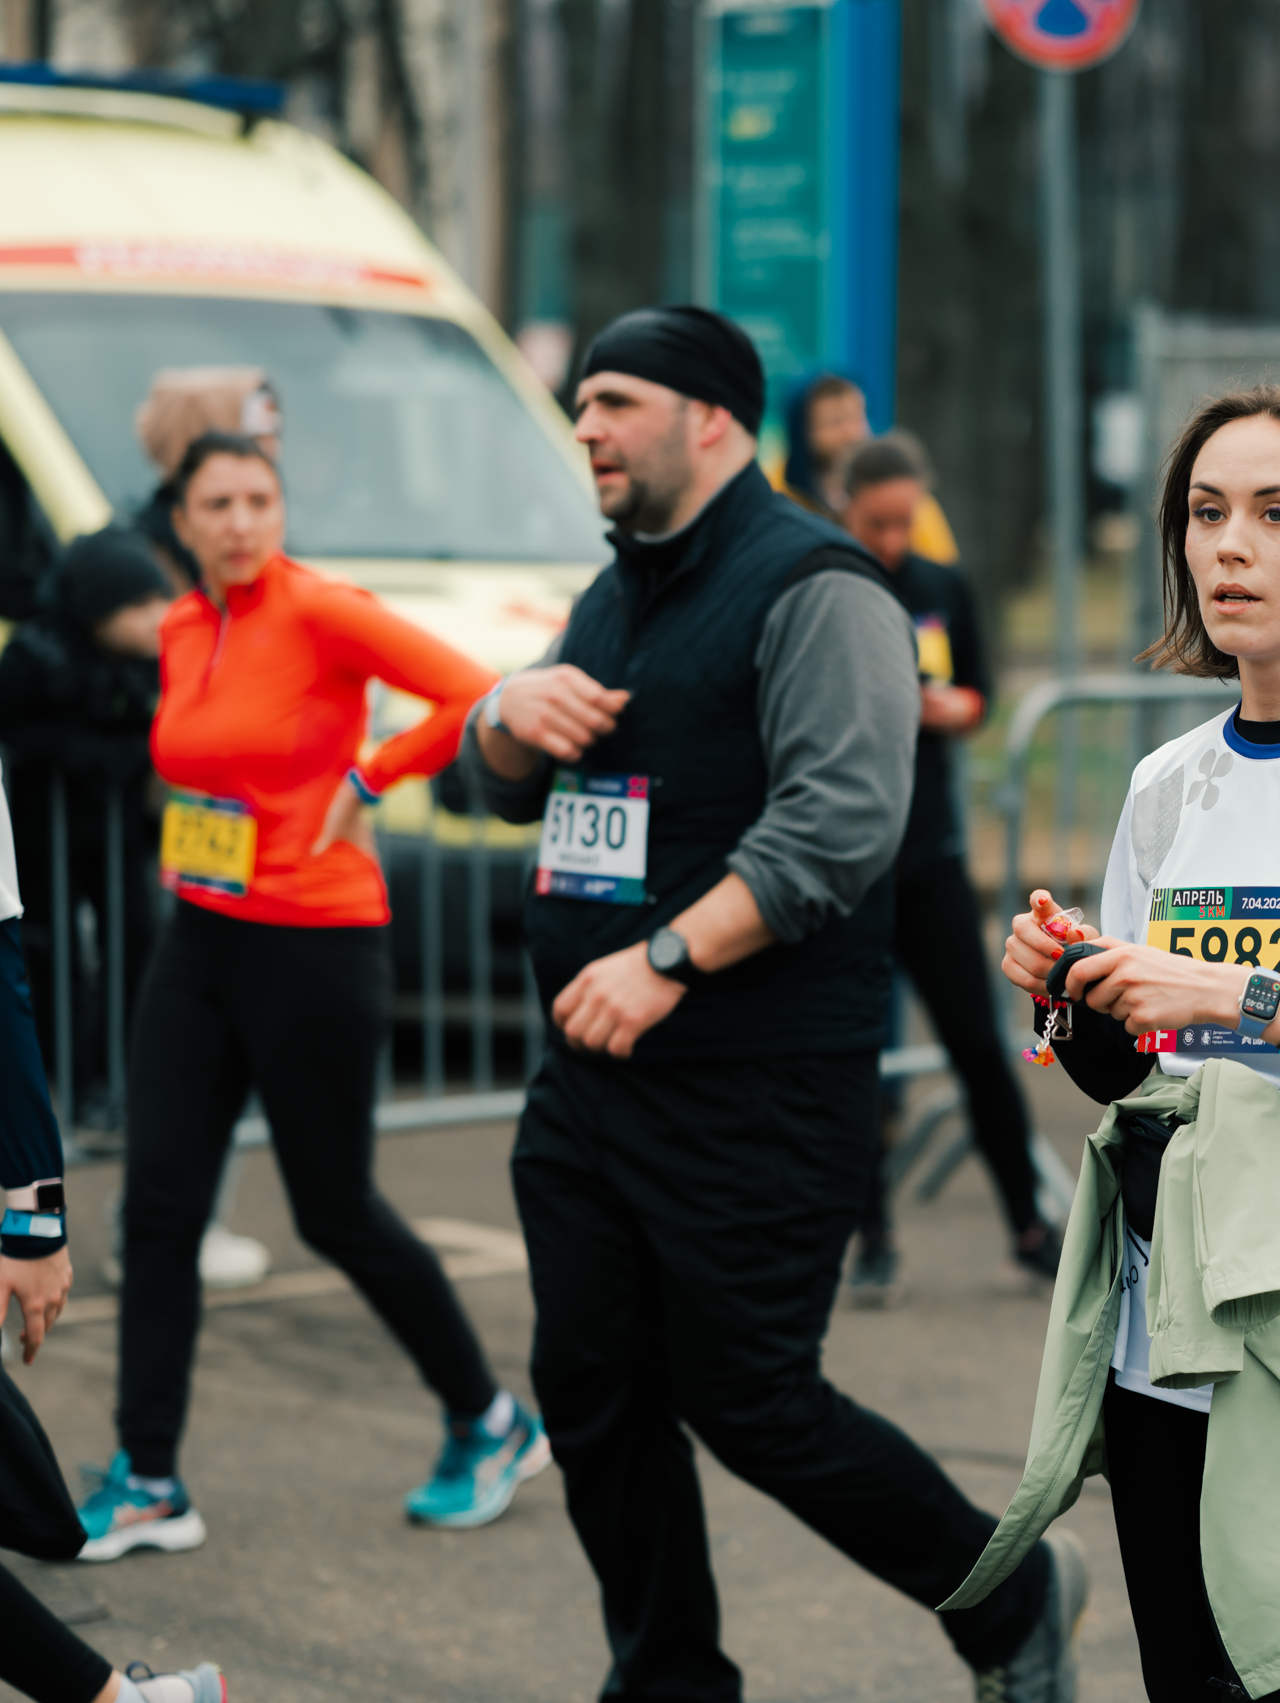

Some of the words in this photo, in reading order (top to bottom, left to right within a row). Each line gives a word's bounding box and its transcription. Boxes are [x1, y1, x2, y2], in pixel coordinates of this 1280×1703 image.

[551, 799, 627, 850] 5130
[1172, 890, 1225, 906] АПРЕЛЬ
[1199, 906, 1206, 918] 5
[1209, 905, 1226, 918] КМ
